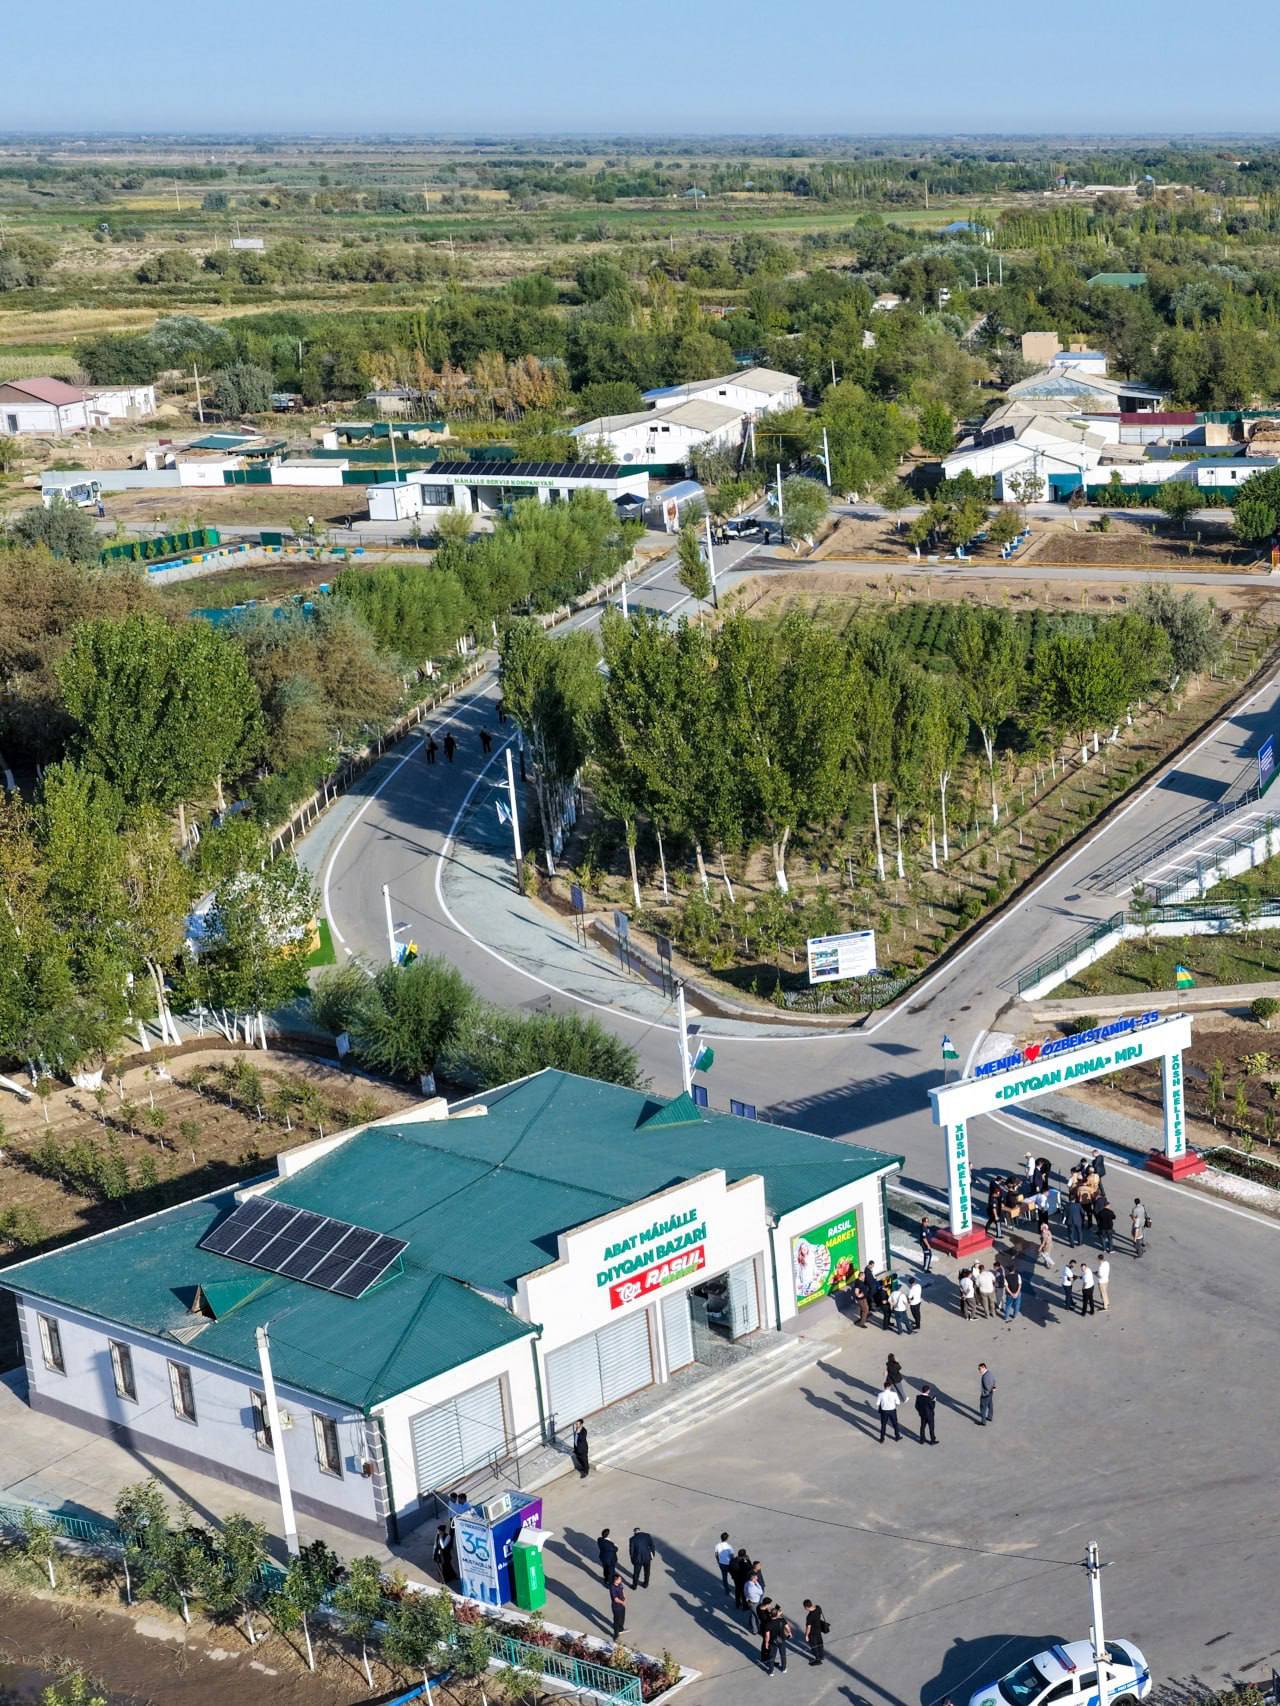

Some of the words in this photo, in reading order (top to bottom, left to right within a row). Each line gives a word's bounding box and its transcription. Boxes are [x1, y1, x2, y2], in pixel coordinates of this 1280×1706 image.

[1115, 1044, 1143, 1064] MPJ
[955, 1123, 965, 1158] XUSH
[958, 1162, 969, 1229] KELIBSIZ
[604, 1236, 638, 1261] ABAT
[640, 1209, 697, 1244] MÁHÁLLE
[826, 1228, 856, 1247] MARKET
[828, 1220, 851, 1237] RASUL
[597, 1250, 654, 1287] DIYQAN
[656, 1222, 707, 1260] BAZARÍ
[645, 1250, 703, 1288] RASUL
[522, 1513, 539, 1527] ATM
[461, 1531, 490, 1561] 35
